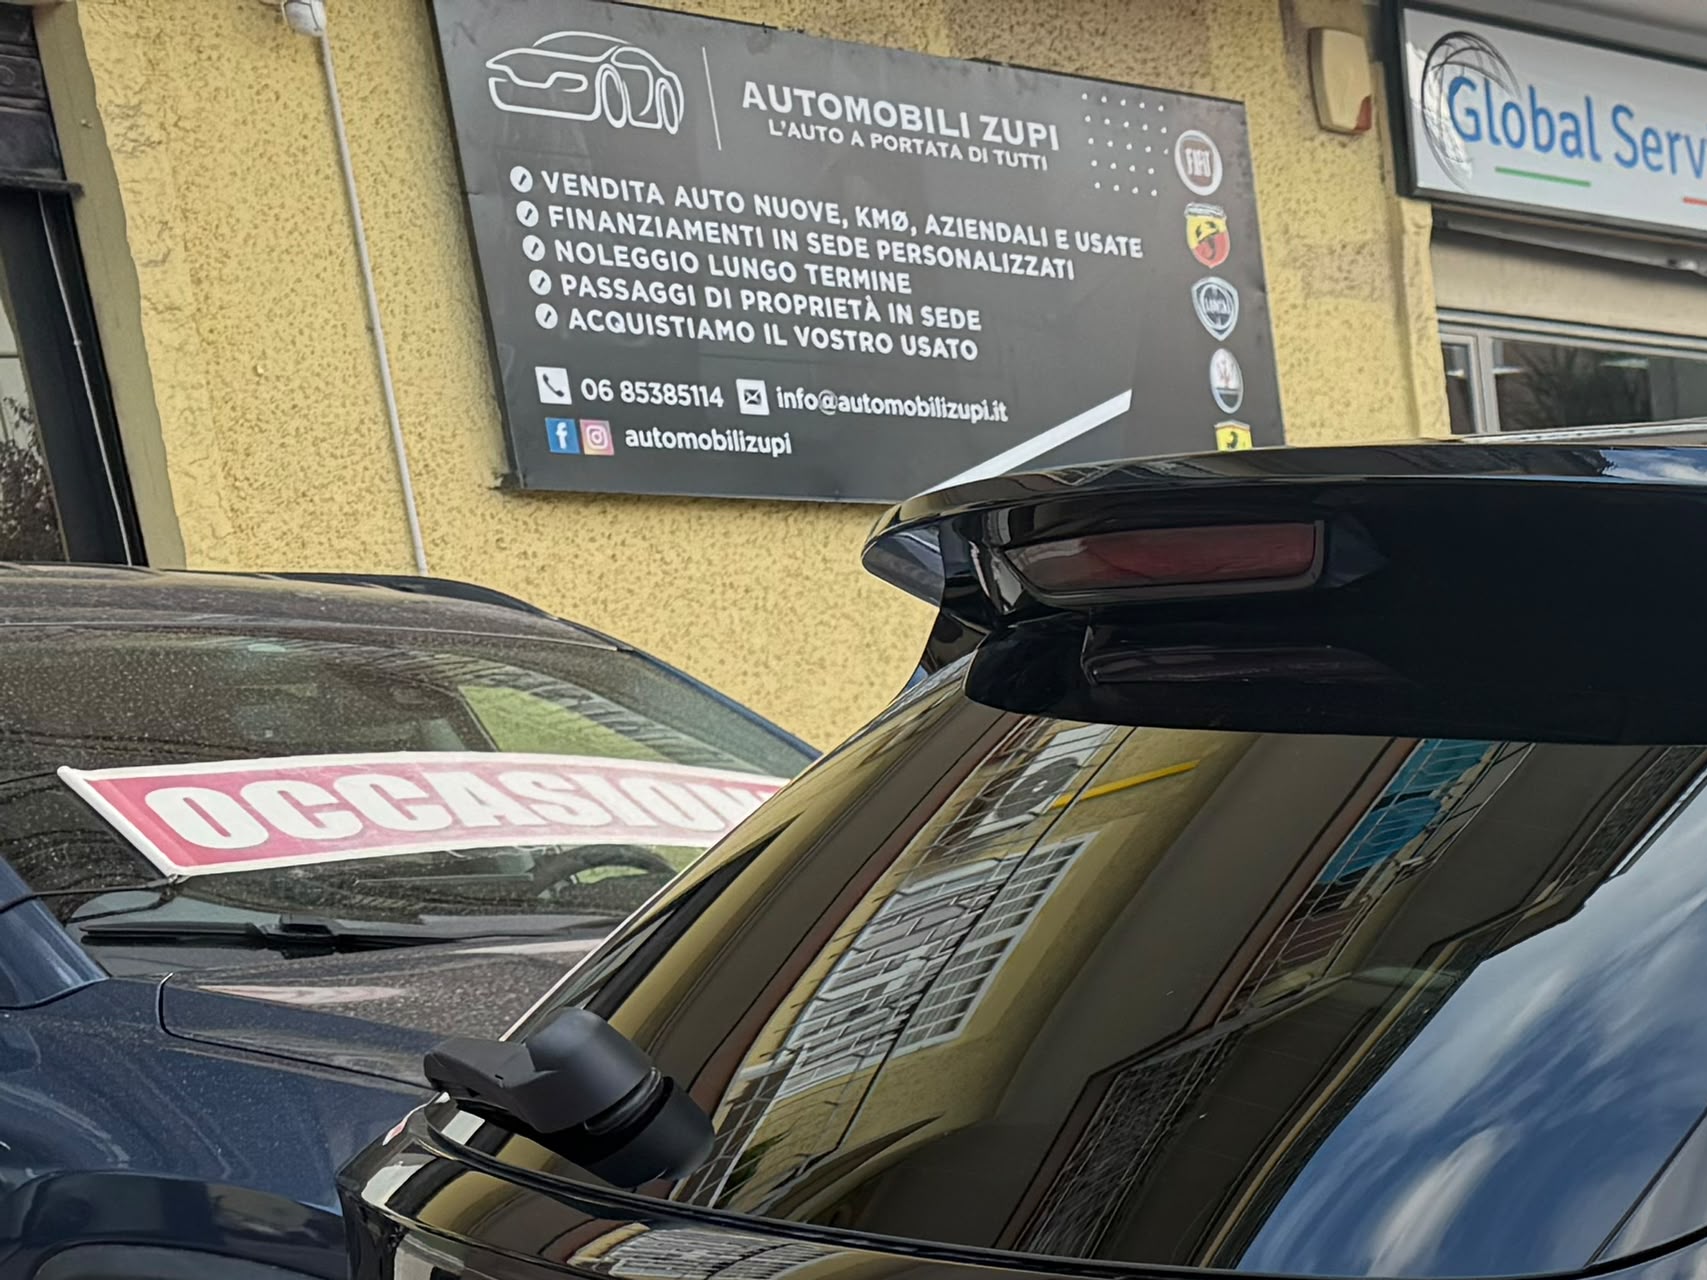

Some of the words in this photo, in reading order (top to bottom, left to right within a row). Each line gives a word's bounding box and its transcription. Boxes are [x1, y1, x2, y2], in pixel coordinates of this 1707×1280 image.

[741, 80, 971, 139] AUTOMOBILI
[978, 114, 1060, 151] ZUPI
[1447, 74, 1601, 163] Global
[850, 129, 865, 147] A
[870, 132, 963, 161] PORTATA
[967, 146, 989, 164] DI
[992, 149, 1049, 171] TUTTI
[540, 170, 666, 206] VENDITA
[674, 185, 745, 214] AUTO
[752, 193, 849, 230] NUOVE,
[924, 213, 1049, 248] AZIENDALI
[1054, 228, 1071, 250] E
[1074, 229, 1144, 259] USATE
[547, 204, 765, 249] FINANZIAMENTI
[771, 227, 800, 252] IN
[805, 231, 871, 259] SEDE
[876, 238, 1075, 281] PERSONALIZZATI
[553, 238, 700, 275] NOLEGGIO
[707, 253, 798, 284] LUNGO
[803, 262, 912, 295] TERMINE
[560, 273, 697, 307] PASSAGGI
[703, 285, 732, 310] DI
[740, 288, 882, 323] PROPRIETÀ
[887, 302, 914, 326] IN
[920, 304, 982, 332] SEDE
[568, 307, 756, 344] ACQUISTIAMO
[763, 323, 788, 347] IL
[792, 324, 895, 355] VOSTRO
[900, 333, 979, 362] USATO
[580, 377, 615, 402] 06
[619, 379, 725, 408] 85385114
[775, 385, 1009, 424] info@automobilizupi.it
[625, 427, 793, 458] automobilizupi
[144, 770, 776, 851] OCCASION
